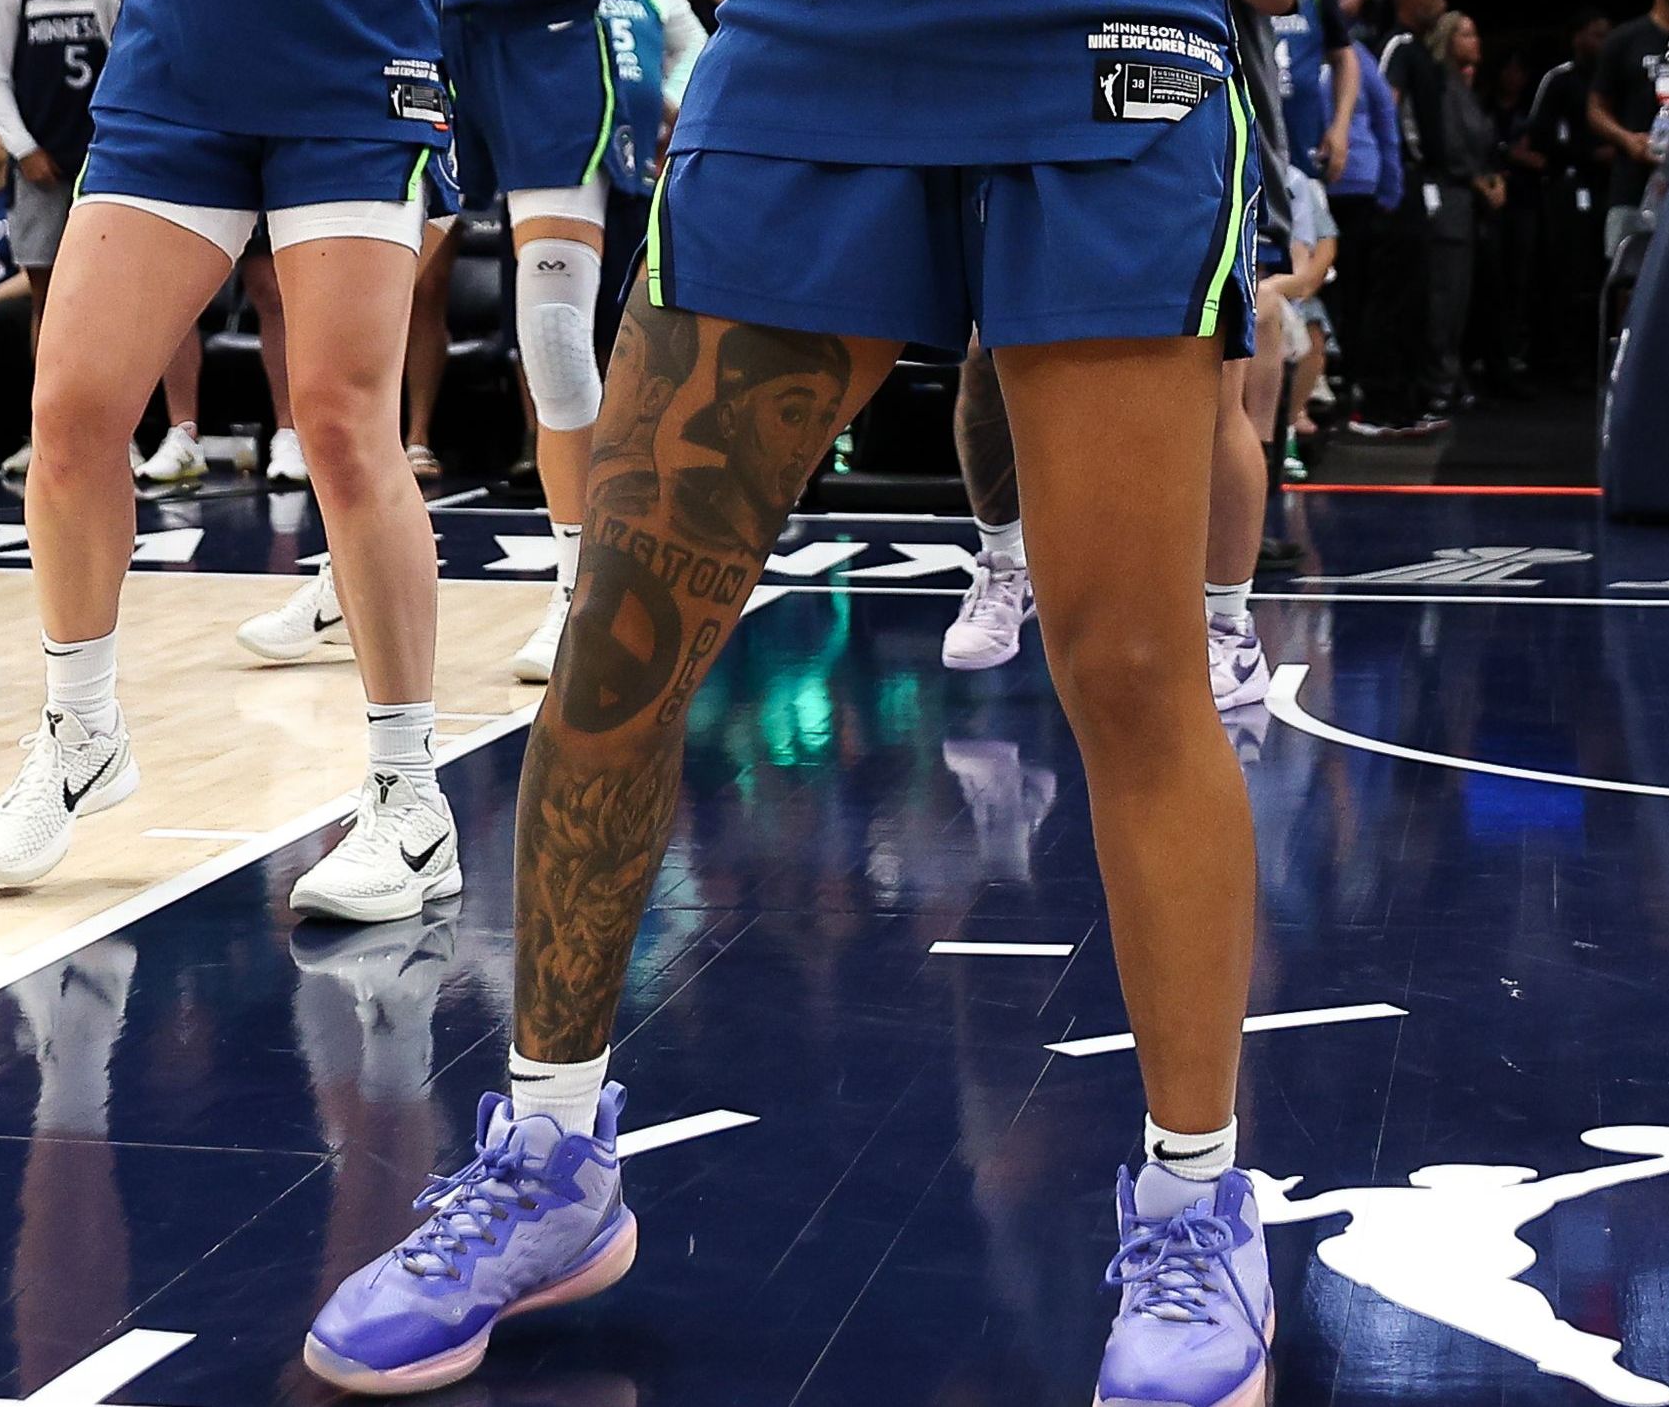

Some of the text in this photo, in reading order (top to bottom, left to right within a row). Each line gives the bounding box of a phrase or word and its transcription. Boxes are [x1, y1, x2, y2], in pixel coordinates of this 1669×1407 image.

[610, 18, 636, 52] 5
[1088, 34, 1122, 49] NIKE
[1121, 36, 1187, 56] EXPLORER
[1102, 22, 1185, 41] MINNESOTA
[65, 44, 92, 88] 5
